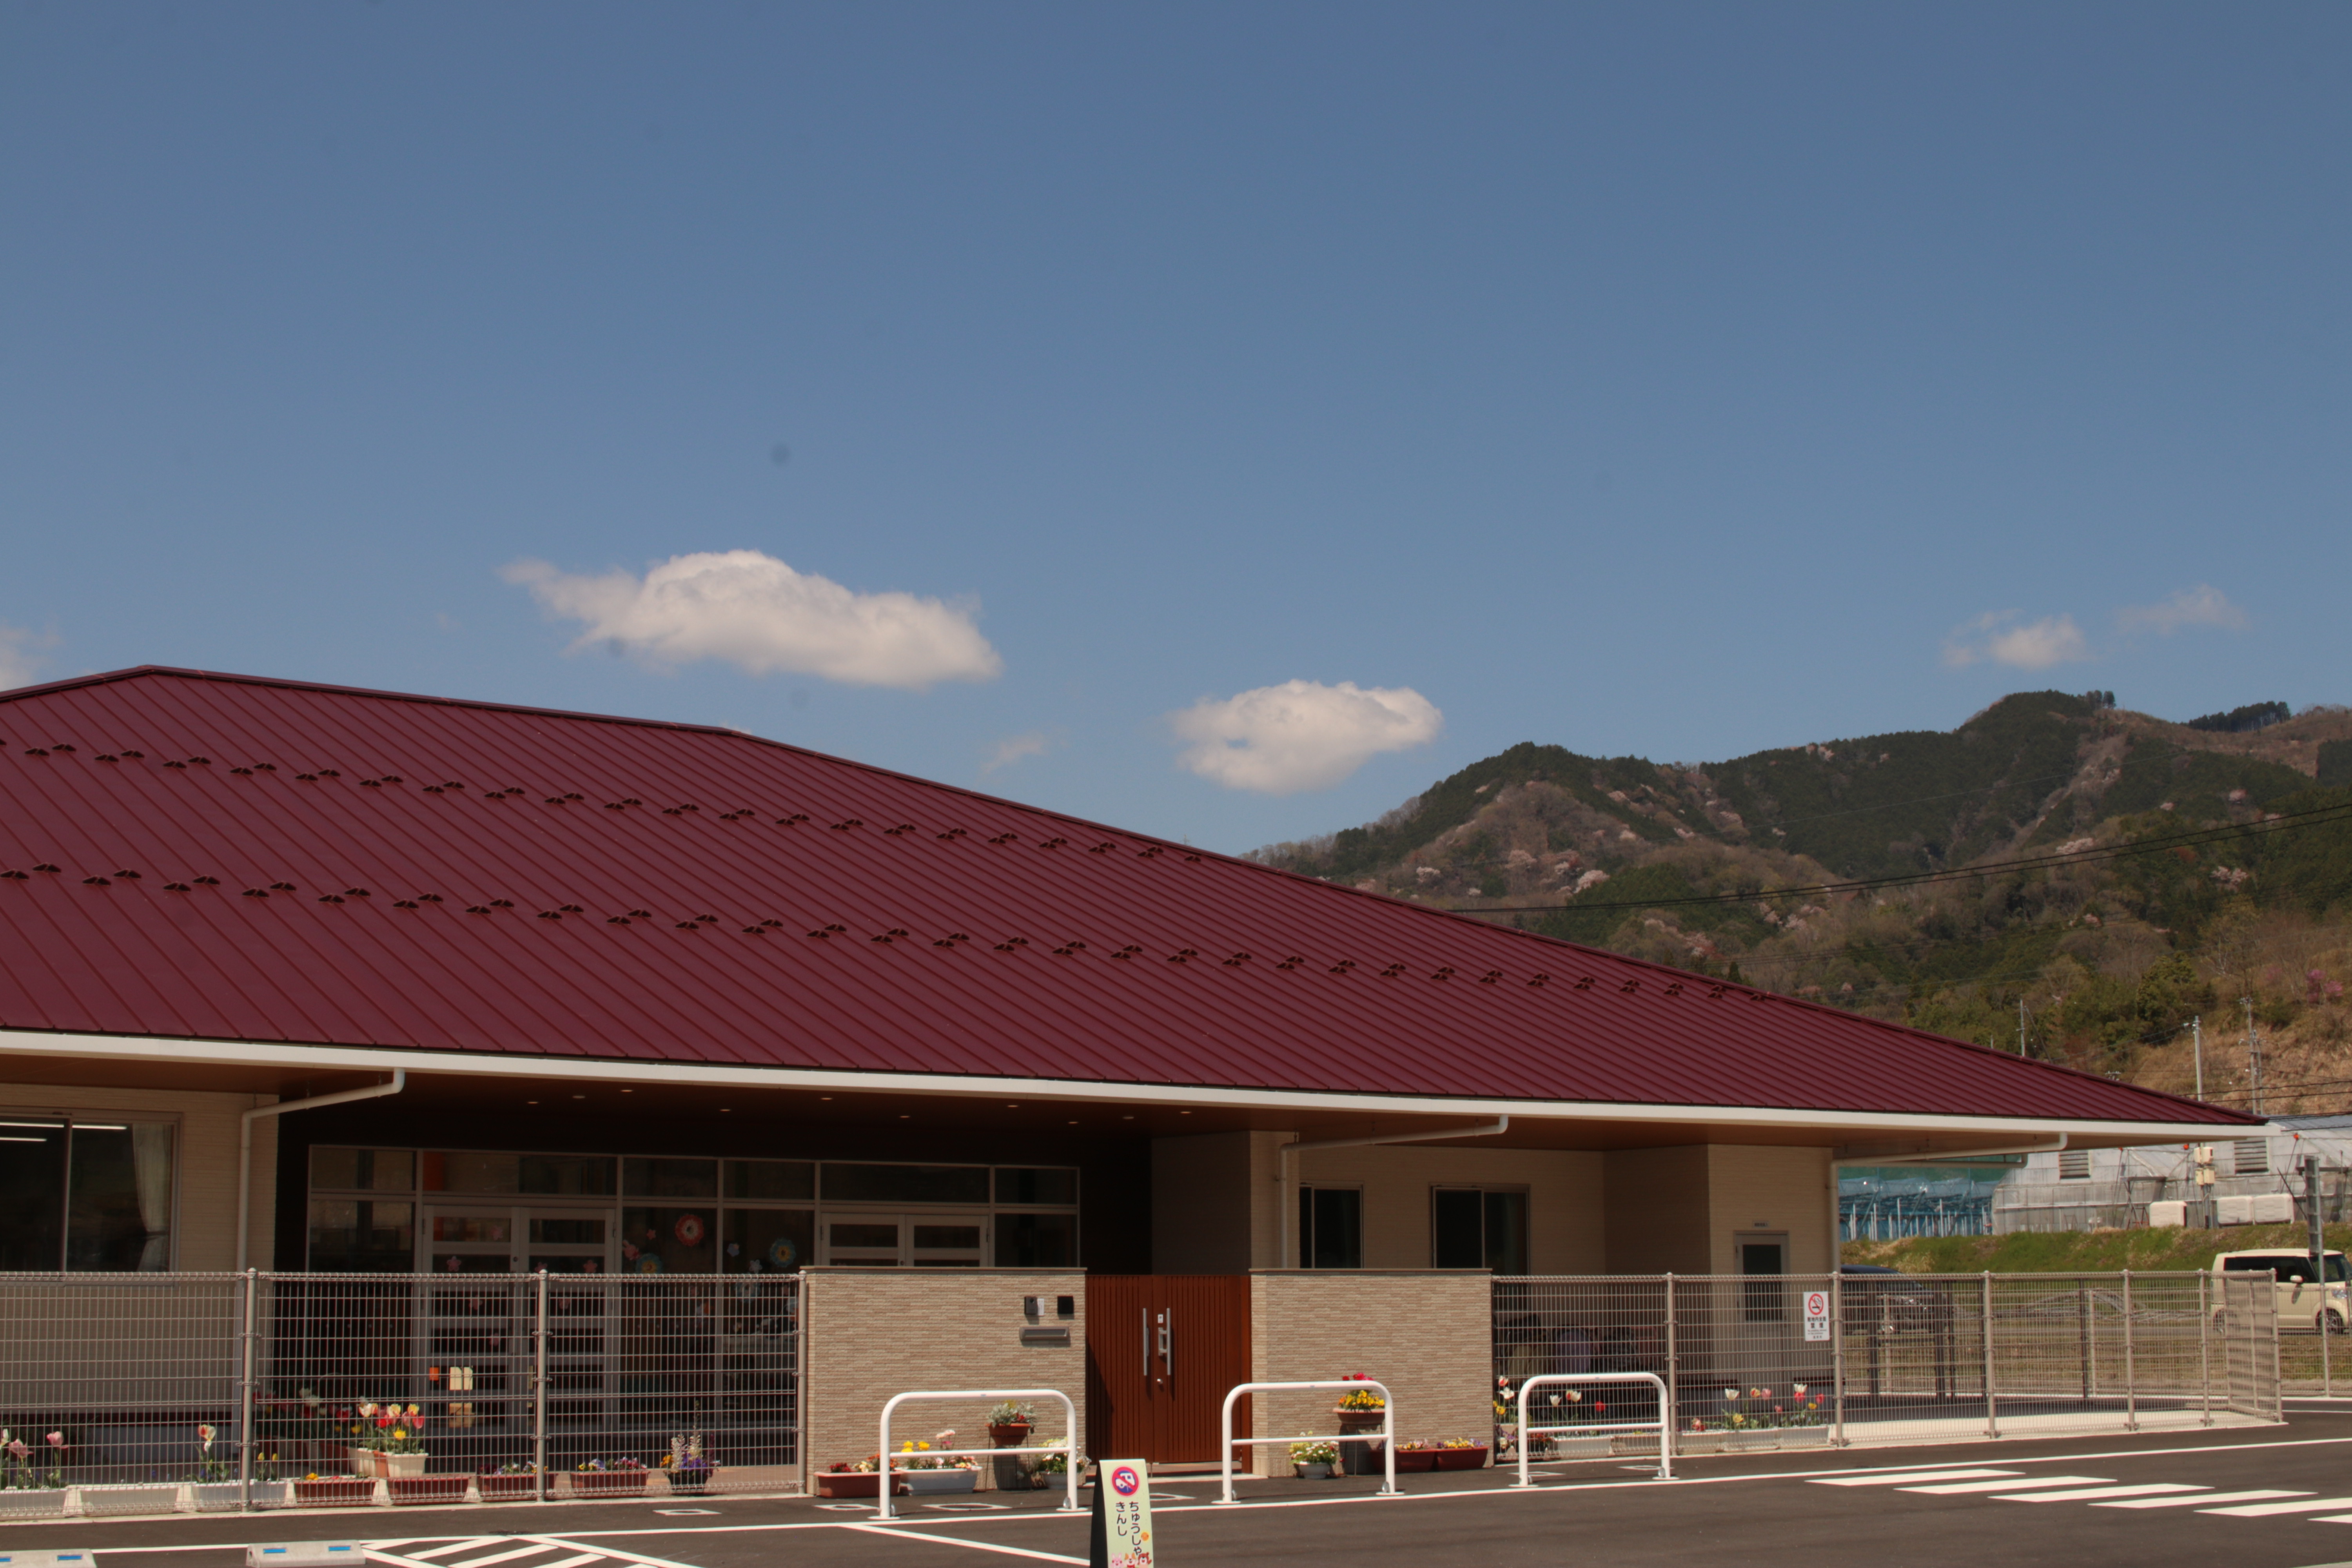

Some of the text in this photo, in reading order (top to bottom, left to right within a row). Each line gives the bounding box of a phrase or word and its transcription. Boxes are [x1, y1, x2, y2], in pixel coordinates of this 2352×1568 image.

[1116, 1502, 1127, 1536] きんし
[1129, 1501, 1142, 1555] ちゅうしゃ
